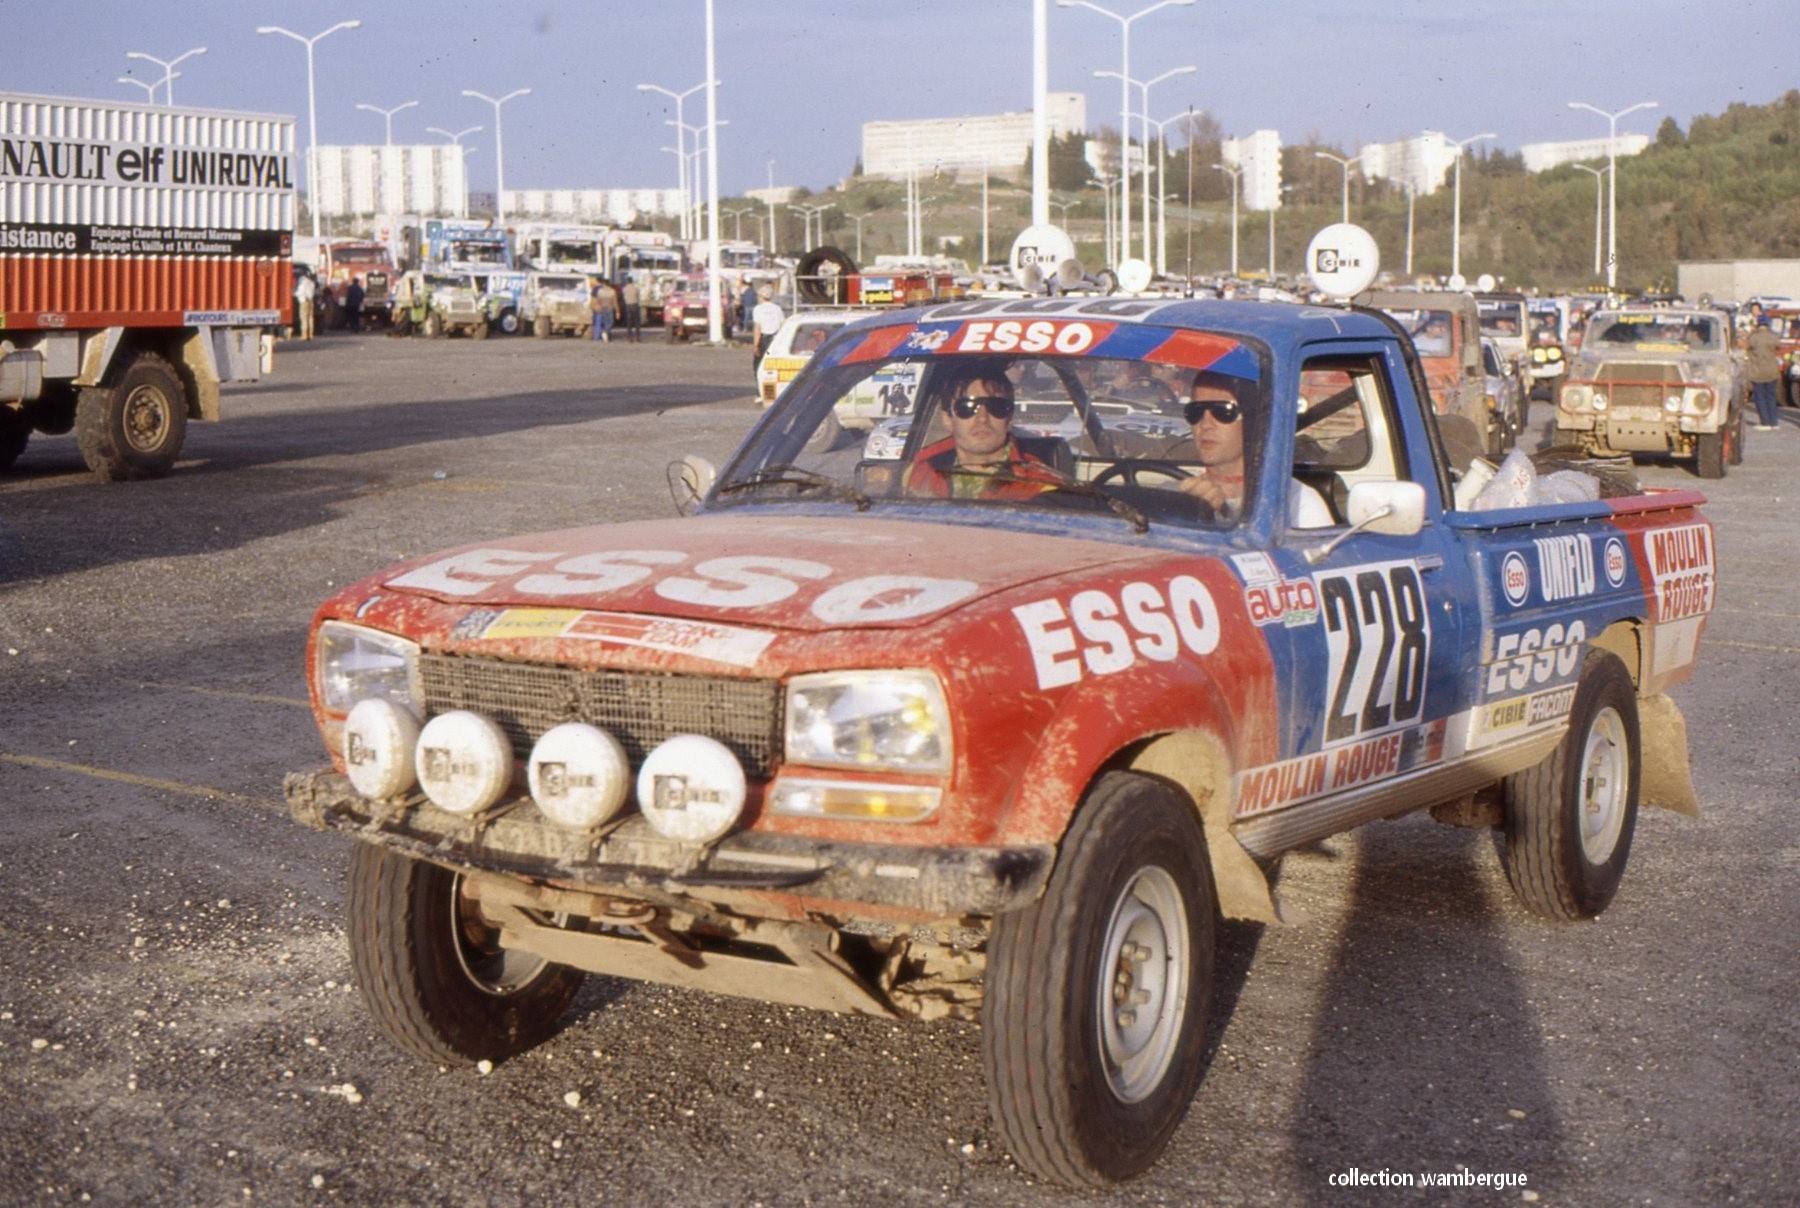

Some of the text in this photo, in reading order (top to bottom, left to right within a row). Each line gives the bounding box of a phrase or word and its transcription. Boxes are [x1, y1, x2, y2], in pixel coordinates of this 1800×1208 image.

[1, 139, 293, 188] NAULT elf UNIROYAL
[0, 224, 77, 250] istance
[958, 321, 1093, 354] ESSO
[1533, 533, 1595, 602] UNIFLO
[1607, 554, 1622, 572] Esso
[1653, 527, 1708, 577] MOULIN
[384, 549, 978, 625] ESSO
[1507, 568, 1524, 589] Esso
[1661, 572, 1708, 622] ROUGE
[1011, 575, 1220, 691] ESSO
[1319, 566, 1428, 743] 228
[1487, 620, 1585, 694] ESSO
[1492, 702, 1526, 728] CIBIE
[1237, 754, 1328, 814] MOULIN
[1333, 734, 1400, 789] ROUGE
